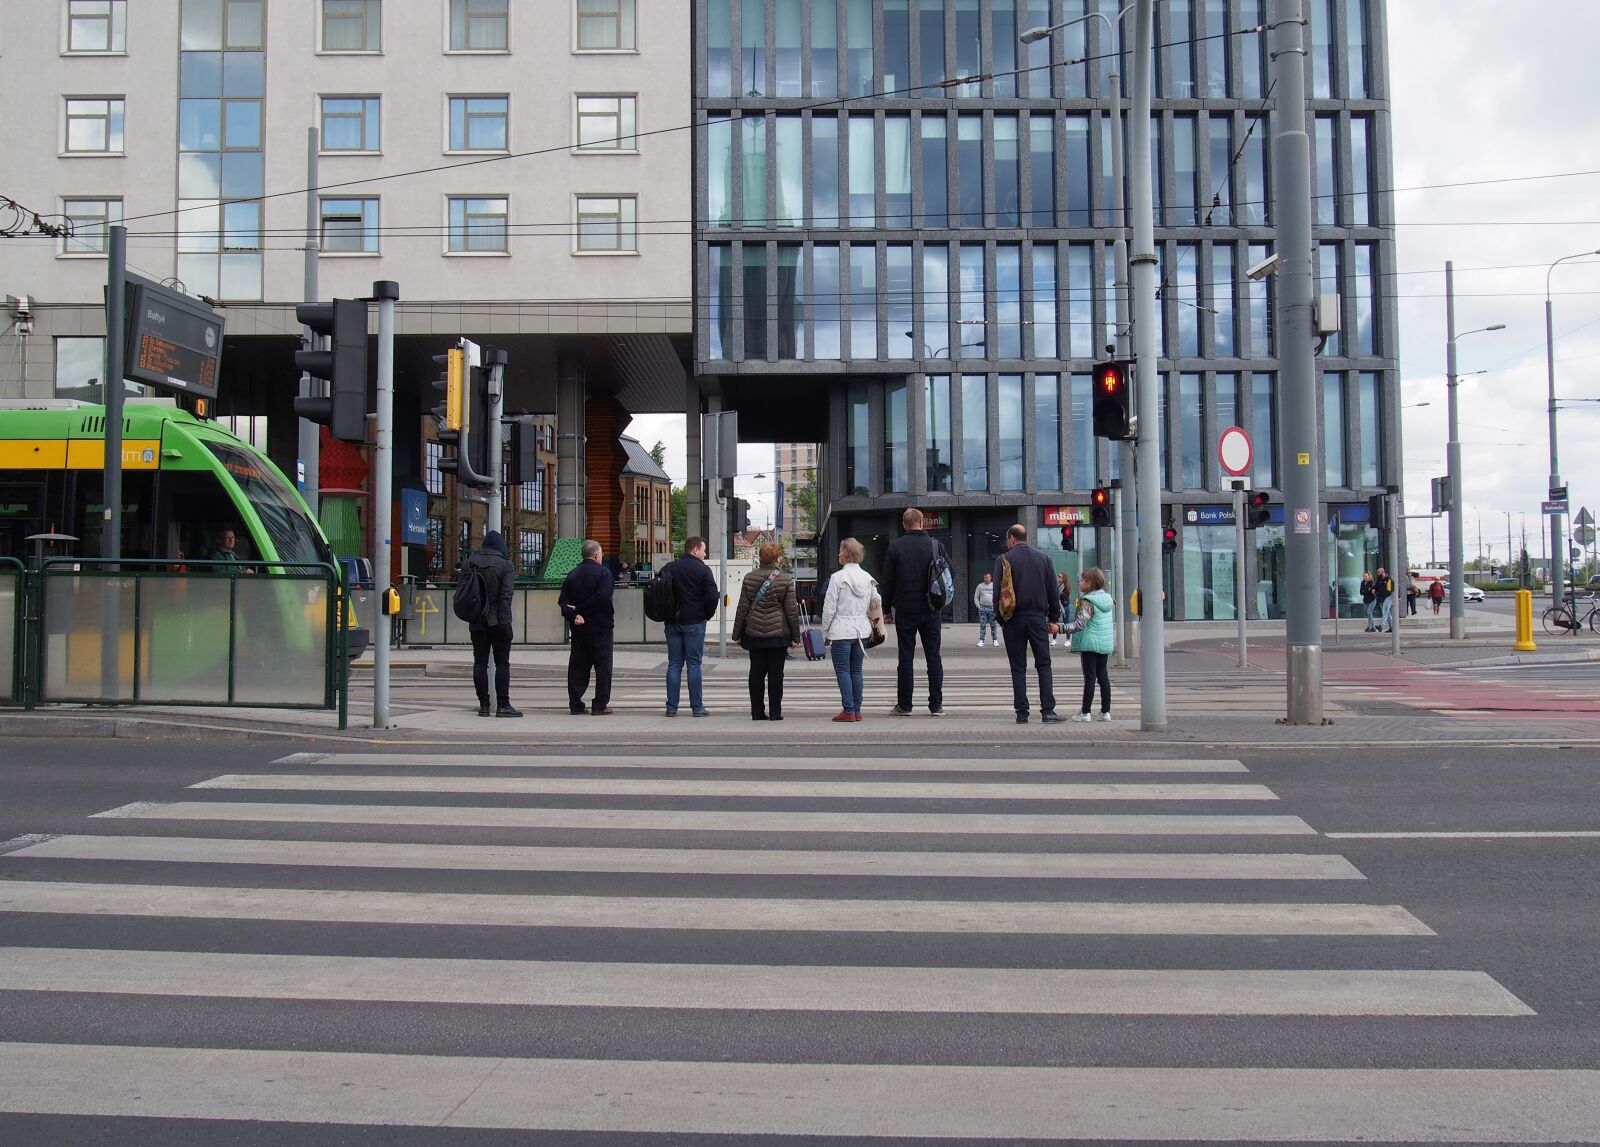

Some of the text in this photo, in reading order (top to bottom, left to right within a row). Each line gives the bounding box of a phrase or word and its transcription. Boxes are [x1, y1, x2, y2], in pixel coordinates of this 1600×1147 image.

[1049, 511, 1085, 521] mBank
[1200, 511, 1218, 519] Bank
[1219, 511, 1237, 519] Polsk
[923, 516, 944, 526] Bank
